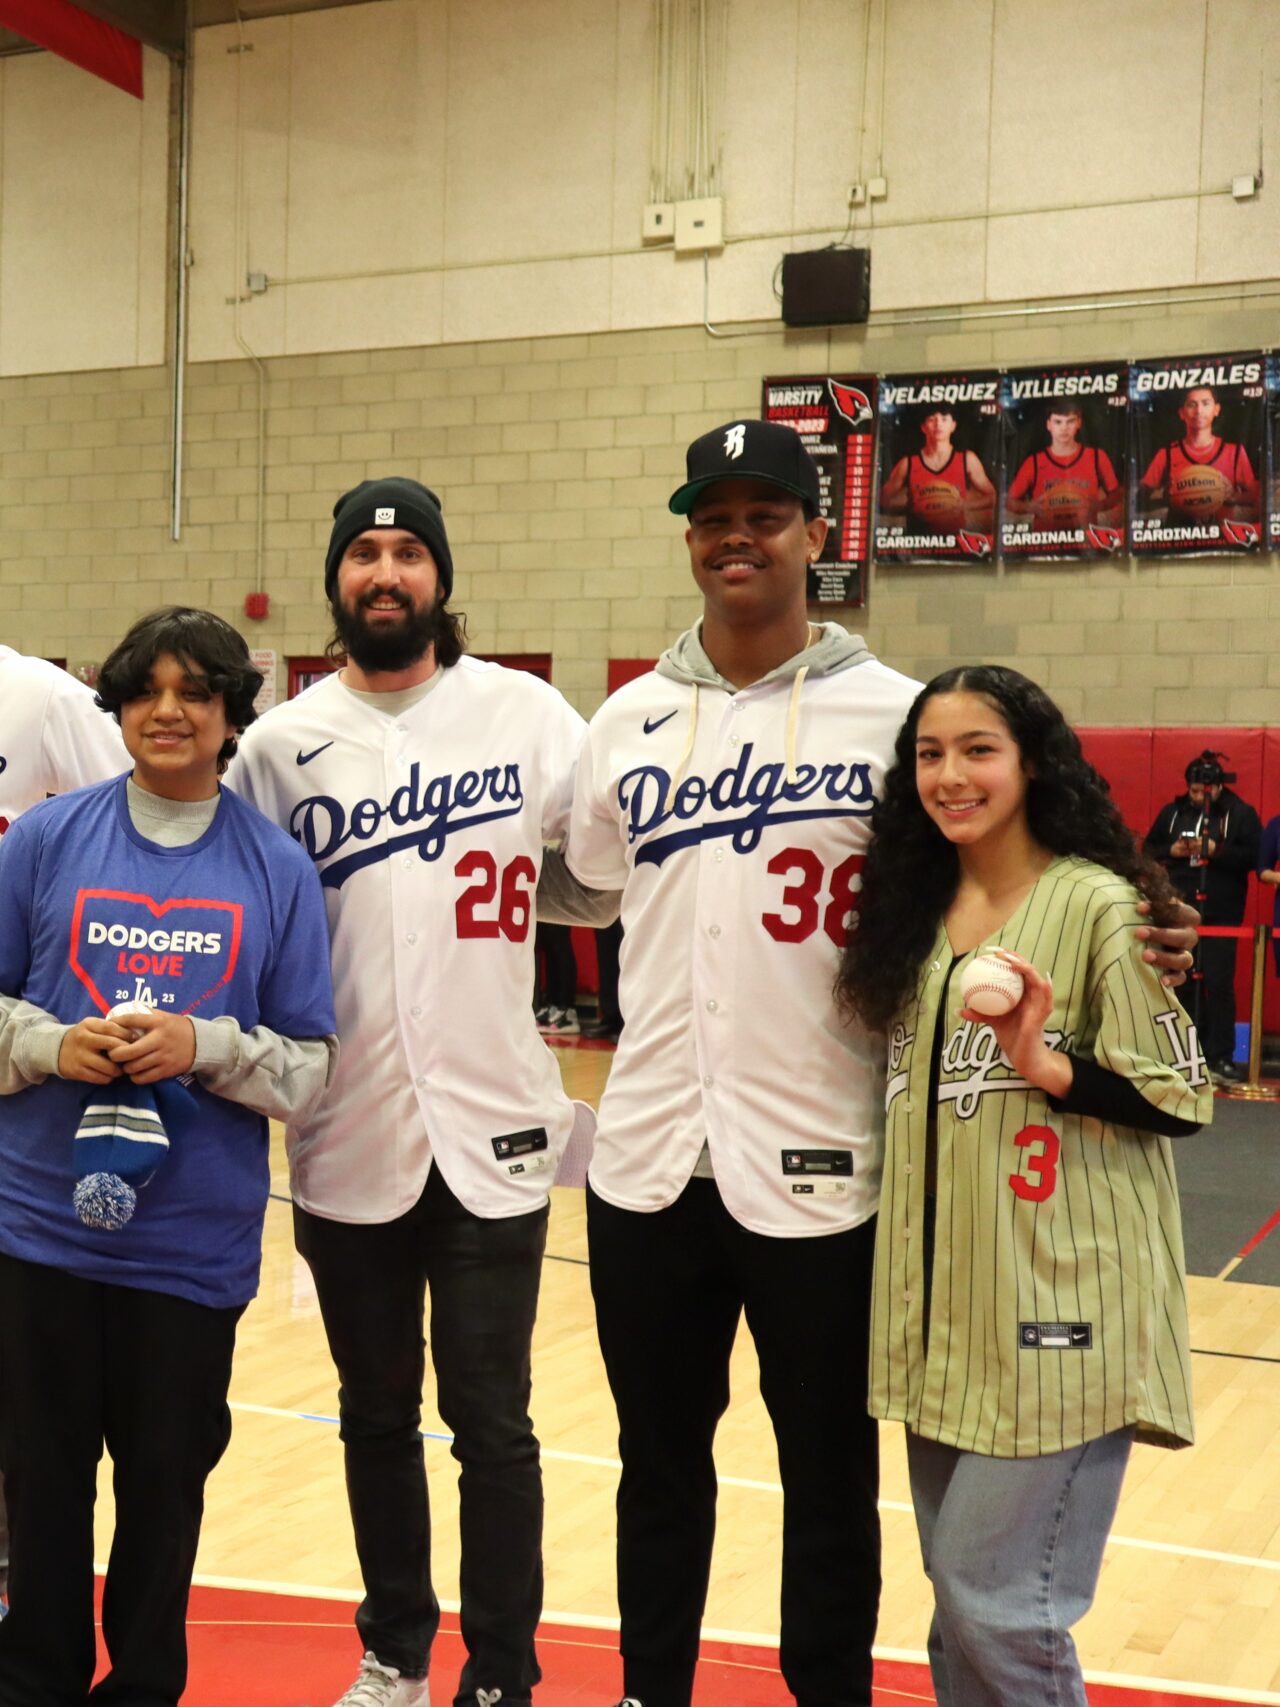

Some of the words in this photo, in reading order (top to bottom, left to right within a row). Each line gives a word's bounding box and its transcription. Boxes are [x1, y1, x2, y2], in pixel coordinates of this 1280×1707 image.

[1012, 373, 1118, 399] VILLESCAS
[1136, 363, 1261, 392] GONZALES
[769, 390, 823, 407] VARSITY
[884, 382, 997, 405] VELASQUEZ
[876, 535, 956, 548] CARDINALS
[1003, 529, 1084, 546] CARDINALS
[1133, 526, 1220, 543] CARDINALS
[290, 761, 523, 862] Dodgers
[618, 742, 878, 855] Dodgers
[455, 850, 536, 943] 26
[762, 847, 868, 948] 38
[88, 922, 222, 955] DODGERS
[117, 951, 184, 976] LOVE
[115, 990, 129, 1000] 20
[133, 977, 158, 1008] LA
[162, 993, 175, 1003] 23
[1009, 1124, 1059, 1203] 3
